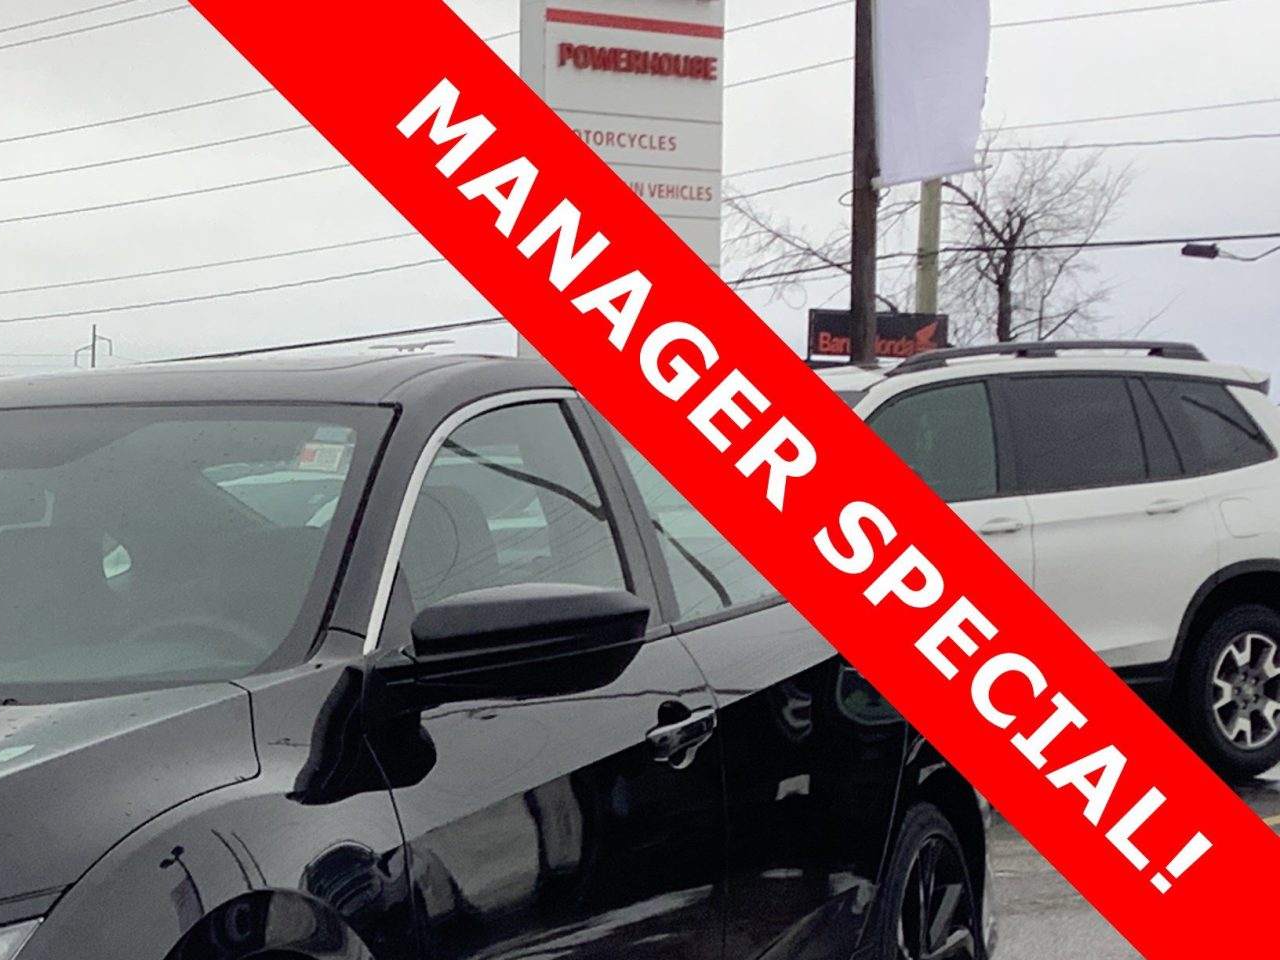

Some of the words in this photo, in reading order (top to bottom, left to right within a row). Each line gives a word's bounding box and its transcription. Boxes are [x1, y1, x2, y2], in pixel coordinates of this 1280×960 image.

[558, 42, 717, 80] POWERHOUSE
[648, 183, 712, 202] VEHICLES
[874, 335, 914, 356] onda
